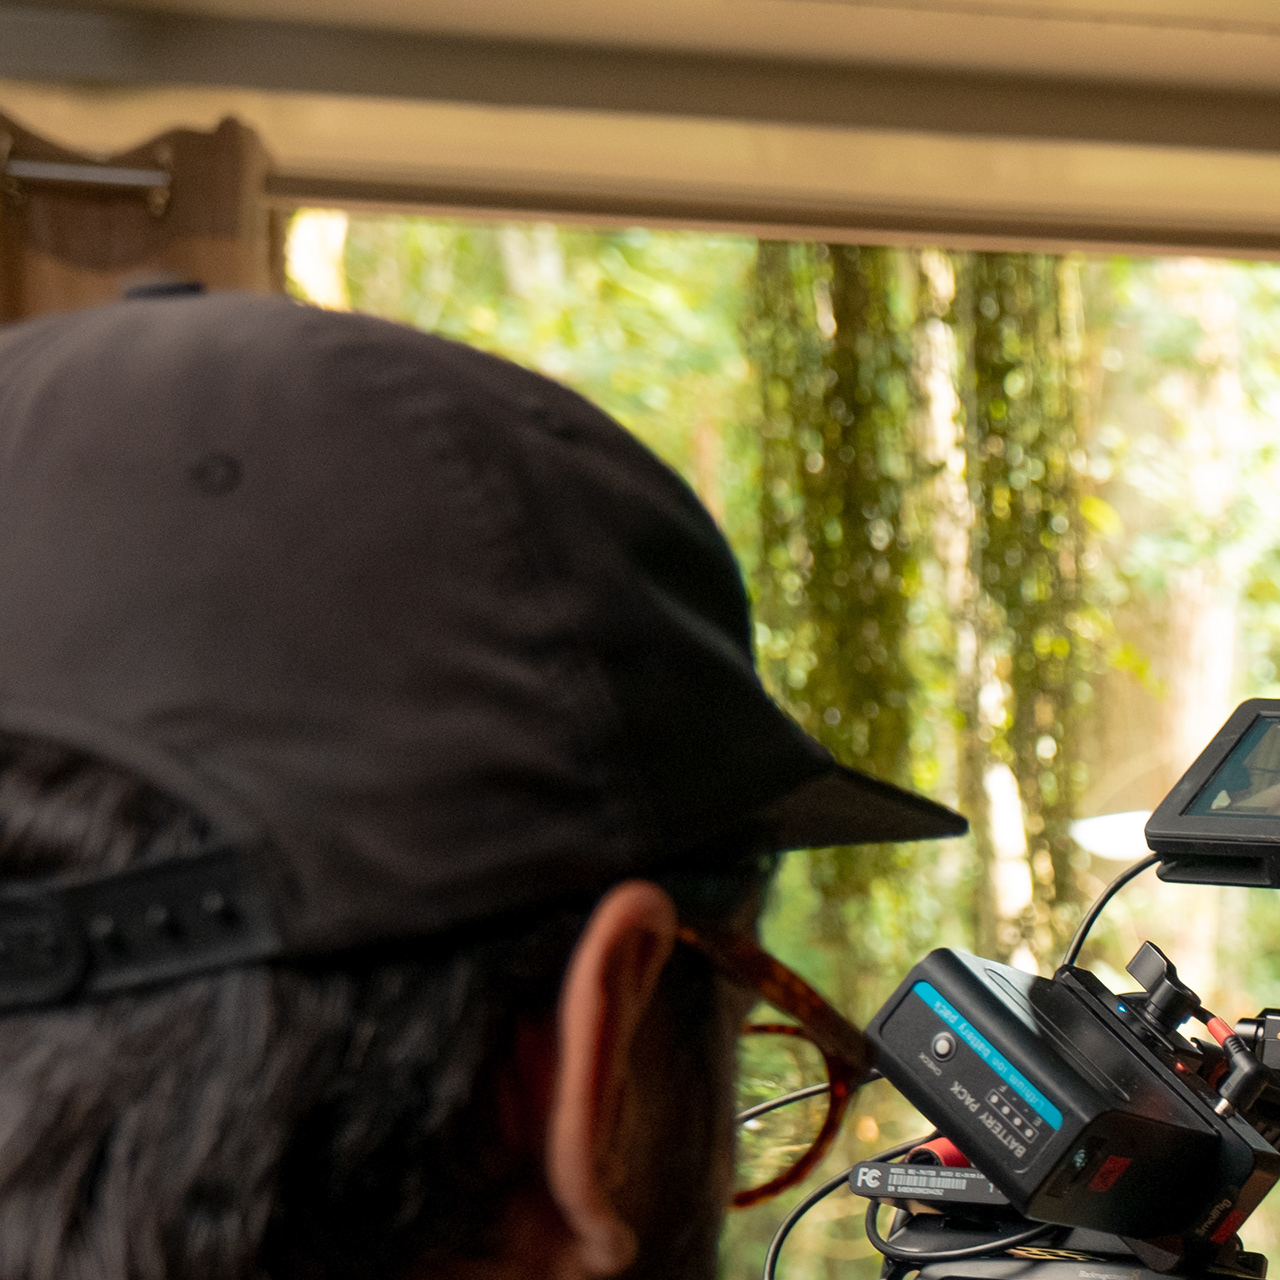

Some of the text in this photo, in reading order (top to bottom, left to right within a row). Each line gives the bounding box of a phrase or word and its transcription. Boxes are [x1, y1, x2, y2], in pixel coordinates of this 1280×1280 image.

[934, 1001, 959, 1023] pack
[958, 1023, 991, 1058] battery
[918, 1052, 942, 1076] CHECK
[950, 1081, 1027, 1158] BATTERY PACK
